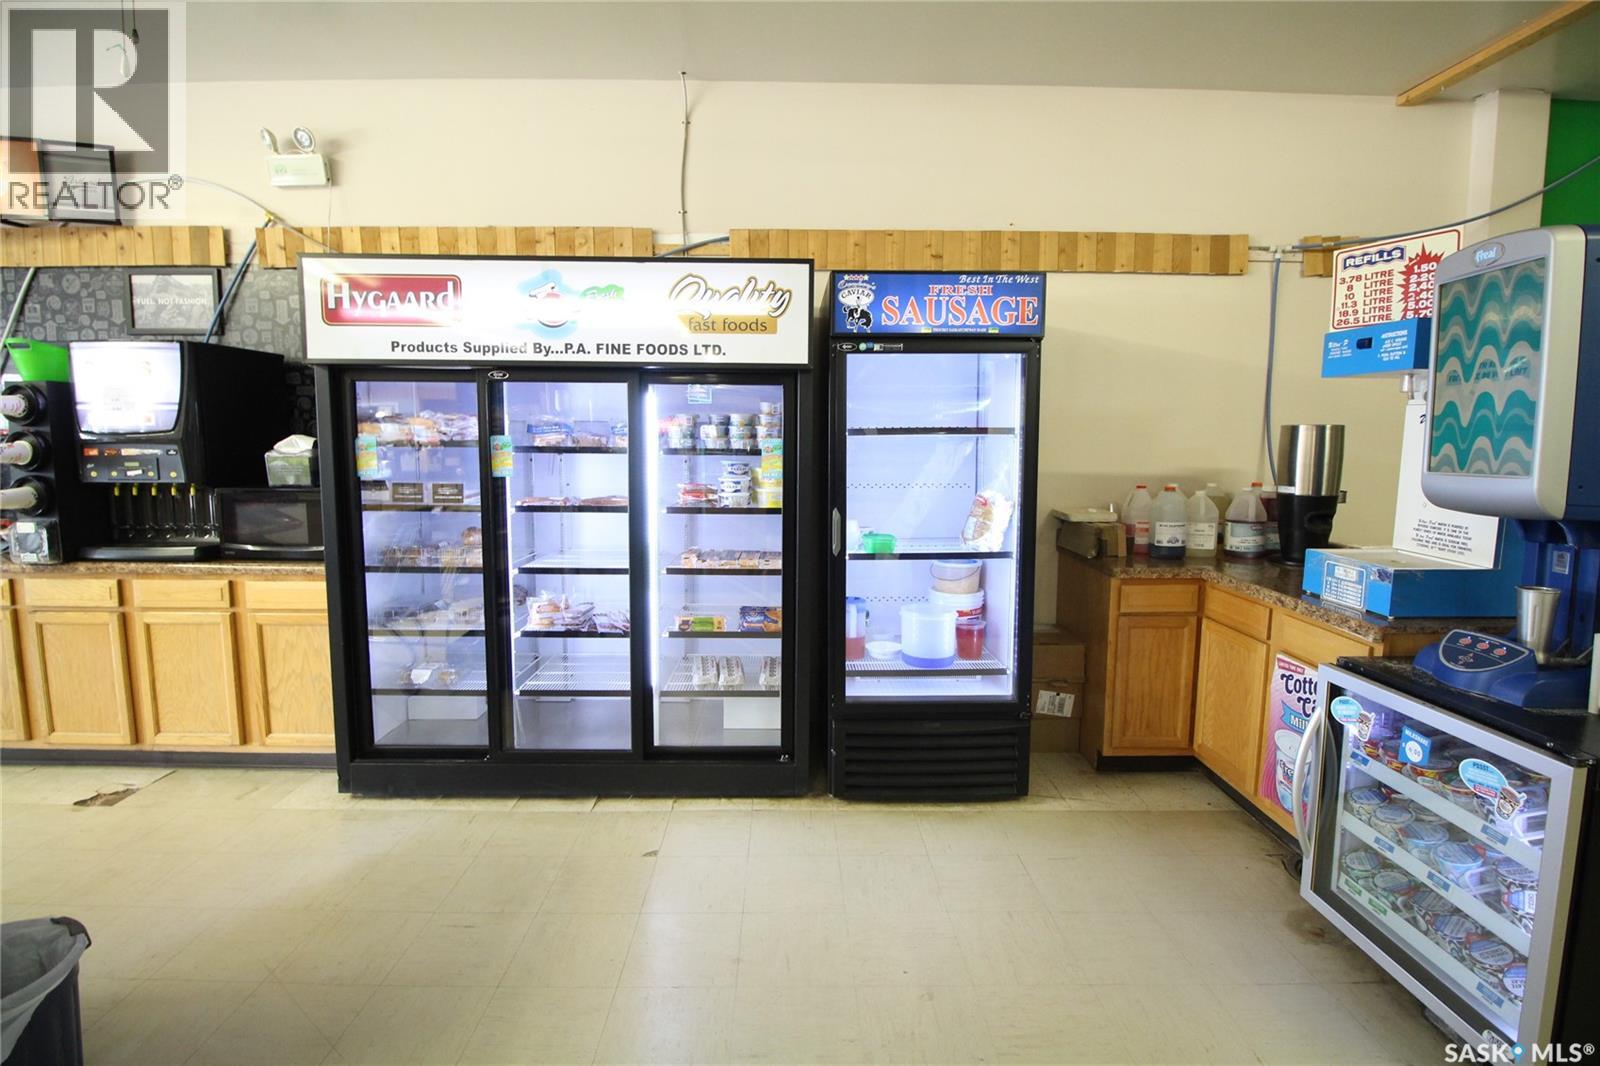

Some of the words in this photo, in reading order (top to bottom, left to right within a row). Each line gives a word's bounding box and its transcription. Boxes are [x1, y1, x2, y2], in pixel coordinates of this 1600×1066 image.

[1344, 248, 1402, 268] REFILLS
[959, 274, 980, 284] Best
[982, 274, 995, 284] In
[995, 274, 1013, 284] The
[1015, 274, 1039, 284] West
[1339, 274, 1363, 285] 3.78
[1364, 269, 1395, 281] LITRE
[1413, 262, 1437, 273] 1.50
[928, 284, 993, 296] FRESH
[1346, 284, 1354, 292] 8
[1364, 278, 1394, 290] LITRE
[669, 273, 792, 318] Quality
[1344, 293, 1355, 301] 10
[1363, 287, 1394, 298] LITRE
[1340, 301, 1358, 310] 11.3
[1363, 295, 1393, 307] LITRE
[881, 295, 1039, 326] SAUSAGE
[1338, 309, 1359, 318] 18.9
[1362, 304, 1393, 315] LITRE
[688, 317, 716, 332] fast
[722, 317, 768, 332] foods
[1336, 317, 1360, 327] 26.5
[1362, 313, 1392, 324] LITRE
[391, 340, 458, 353] Products
[463, 341, 527, 357] Supplied
[596, 343, 631, 356] FINE
[636, 343, 688, 356] FOODS
[693, 344, 727, 356] LTD.
